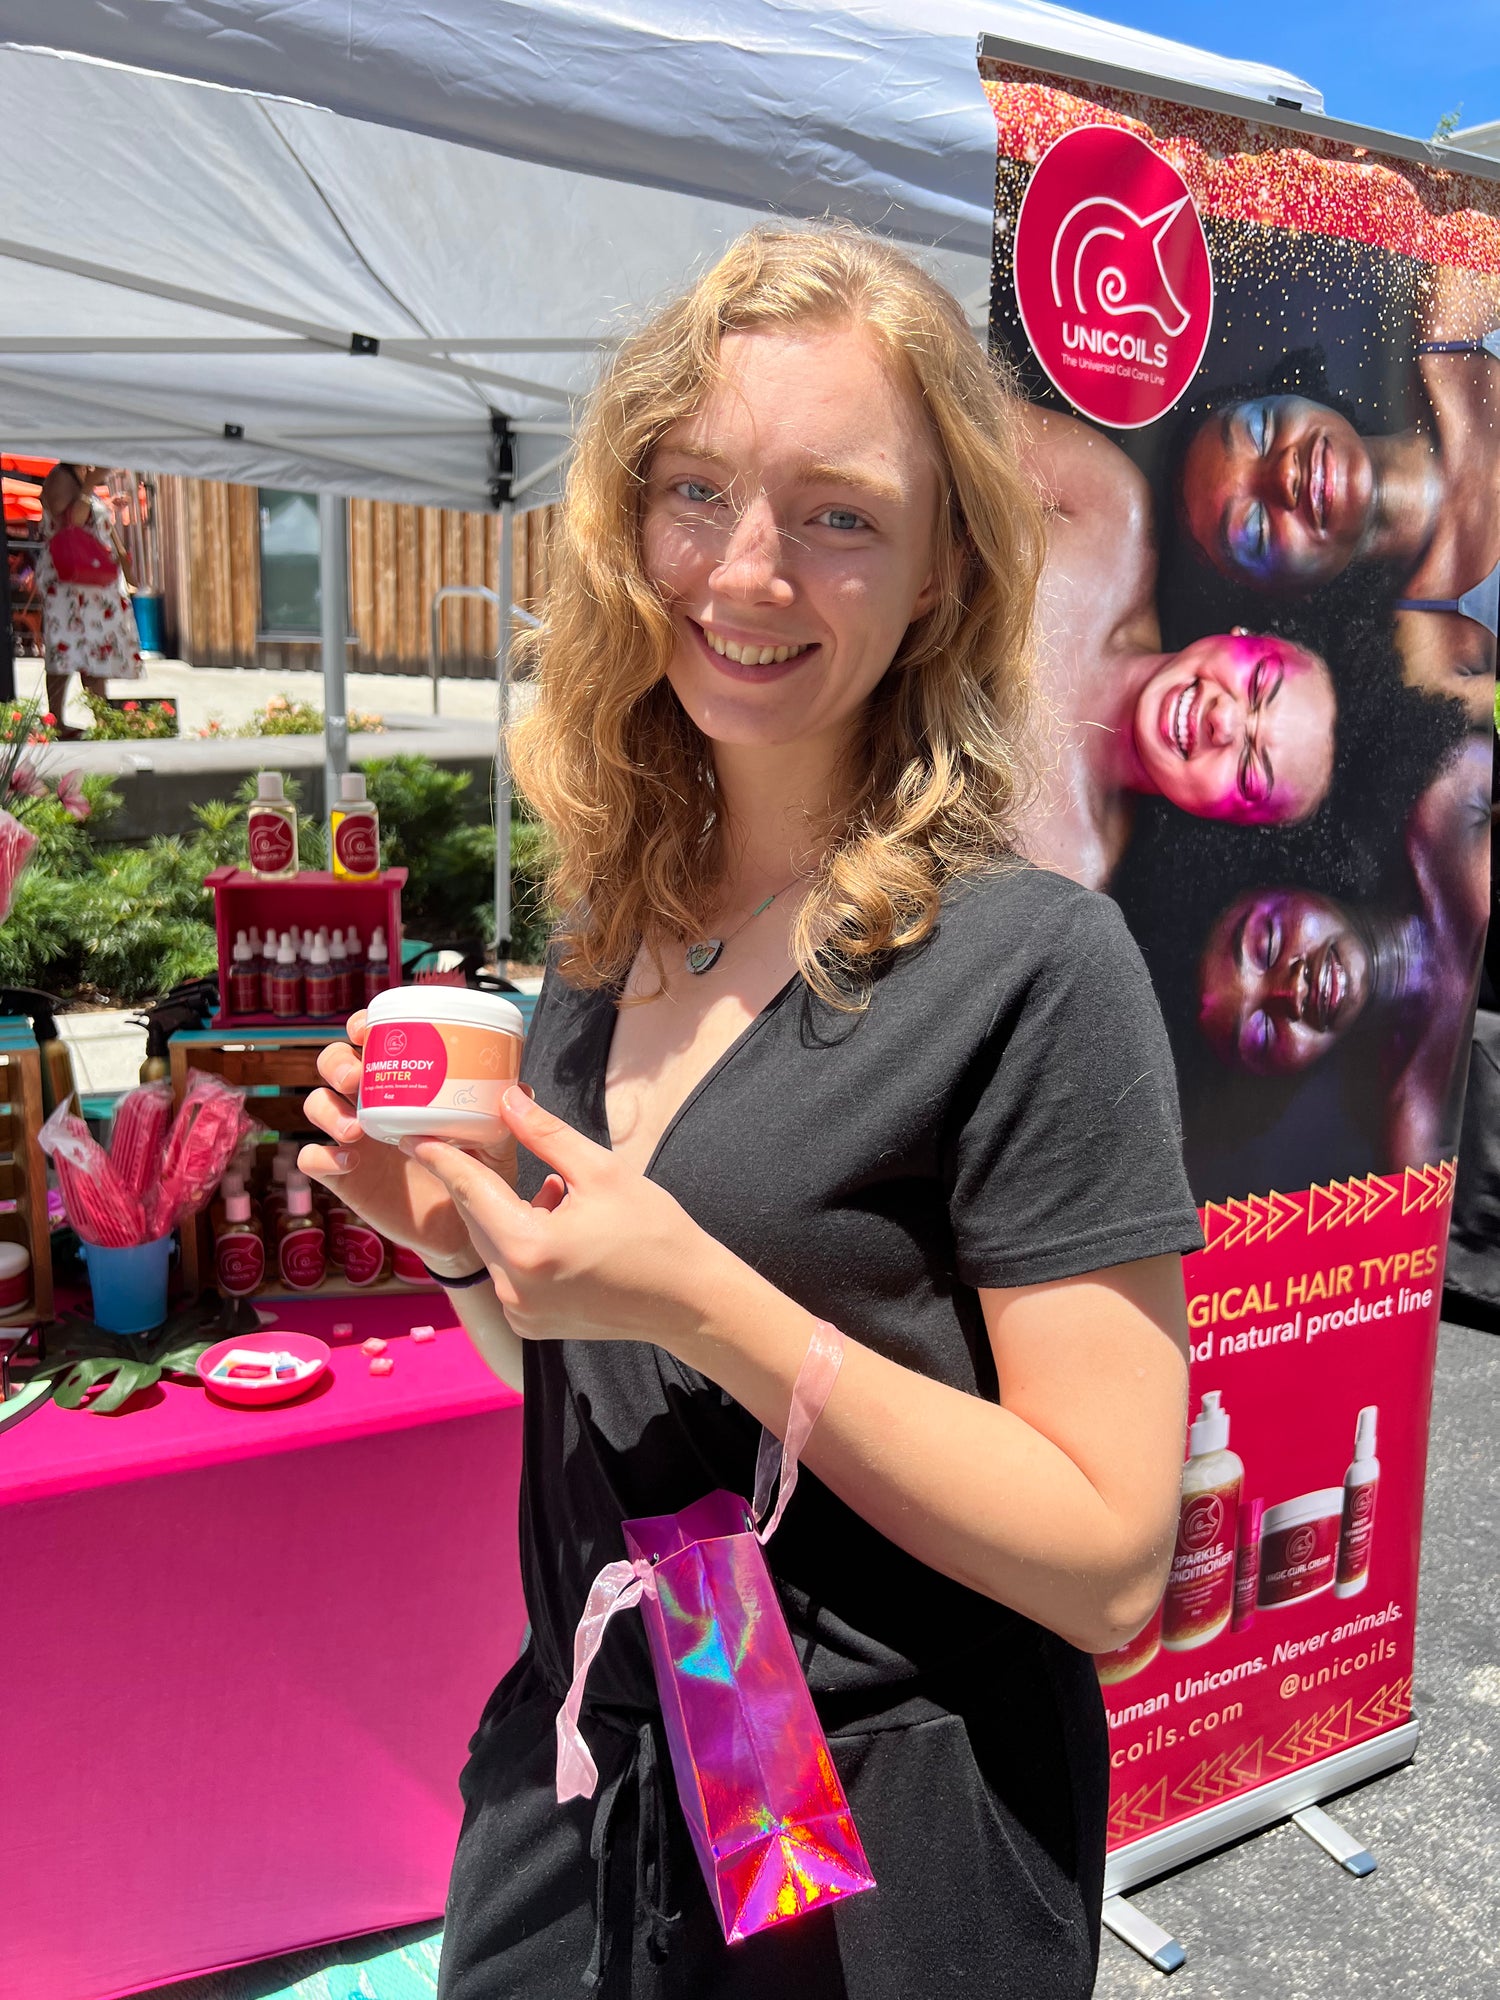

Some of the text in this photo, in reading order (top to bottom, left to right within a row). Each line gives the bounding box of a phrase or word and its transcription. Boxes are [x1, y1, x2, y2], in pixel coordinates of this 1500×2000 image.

[1062, 321, 1168, 368] UNICOILS
[1061, 352, 1079, 368] The
[1078, 356, 1116, 375] Universal
[1131, 368, 1150, 382] Care
[1150, 372, 1166, 386] Line
[365, 1059, 434, 1073] SUMMER BODY
[374, 1071, 411, 1082] BUTTER
[1187, 1244, 1438, 1328] GICAL HAIR TYPES
[1219, 1311, 1302, 1357] natural
[1306, 1295, 1393, 1344] product
[1398, 1287, 1433, 1315] line
[1174, 1542, 1224, 1570] SPARKLE
[1175, 1656, 1267, 1703] Unicorns.
[1271, 1630, 1329, 1666] Never
[1330, 1600, 1402, 1643] animals.
[1111, 1637, 1397, 1768] coils.com @unicoils
